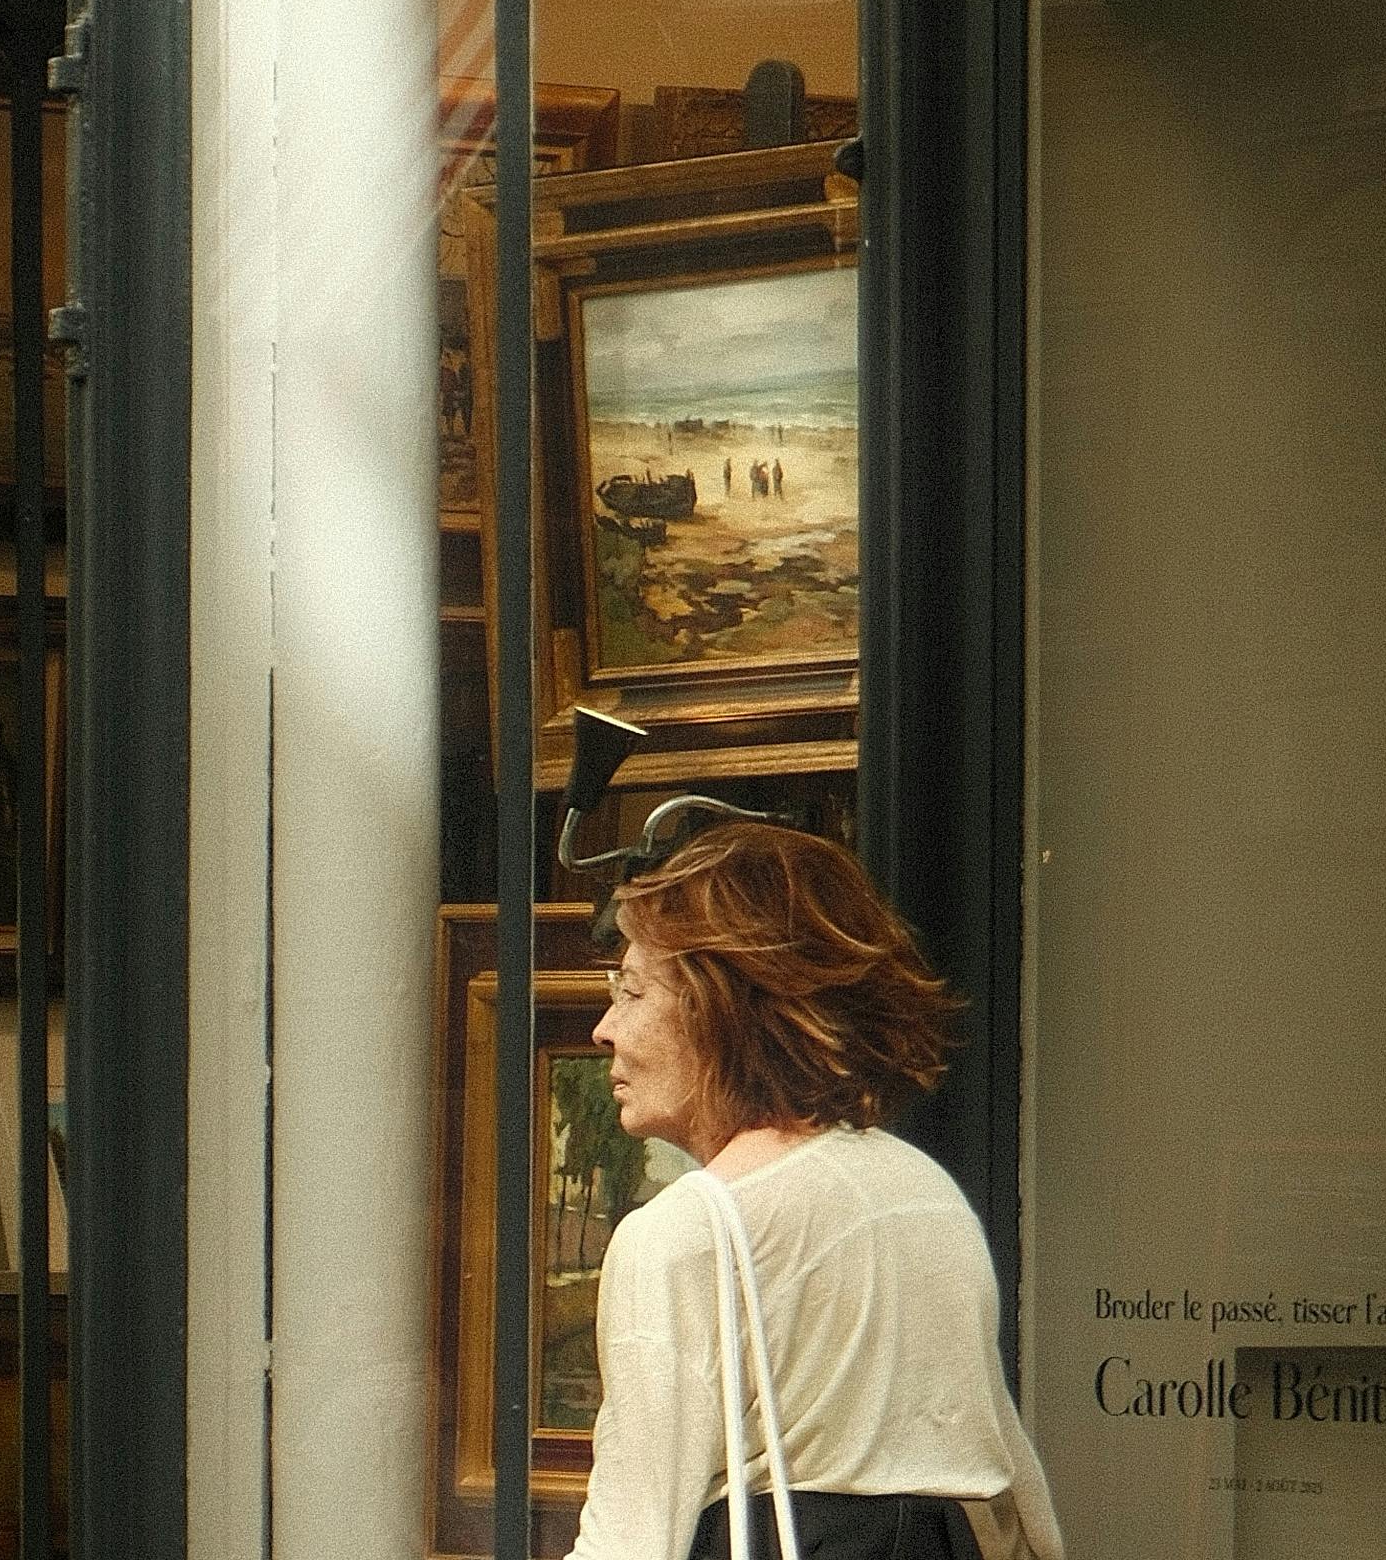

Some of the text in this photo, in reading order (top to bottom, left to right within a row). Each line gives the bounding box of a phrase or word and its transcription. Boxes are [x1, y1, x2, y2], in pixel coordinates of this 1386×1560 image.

[1095, 1288, 1175, 1321] Broder
[1184, 1290, 1203, 1321] le
[1293, 1296, 1357, 1325] tisser
[1094, 1356, 1253, 1419] Carolle
